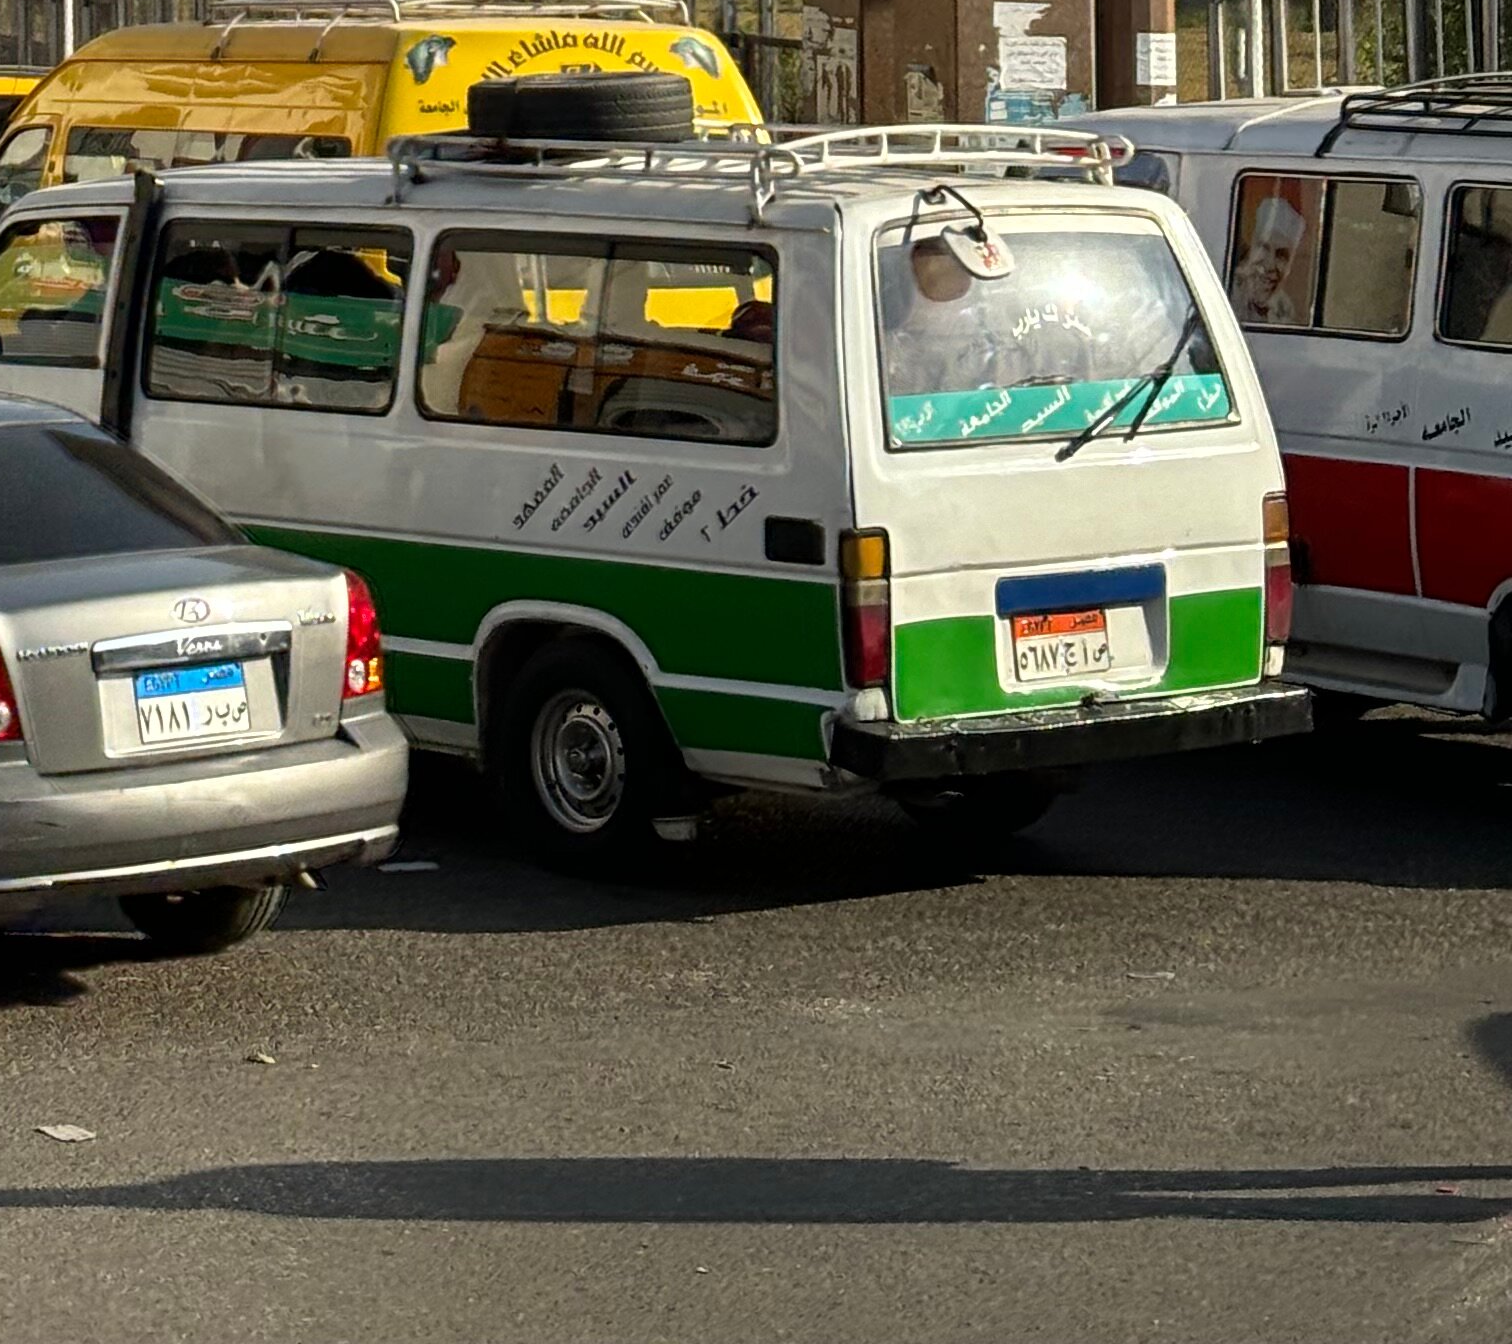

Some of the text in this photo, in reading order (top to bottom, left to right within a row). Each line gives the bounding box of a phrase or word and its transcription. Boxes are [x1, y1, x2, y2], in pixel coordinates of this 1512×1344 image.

[583, 31, 626, 57] الله
[1021, 385, 1071, 433] السيد
[583, 469, 637, 533] السيد
[715, 484, 760, 531] خط
[140, 701, 191, 735] ٧١٨١
